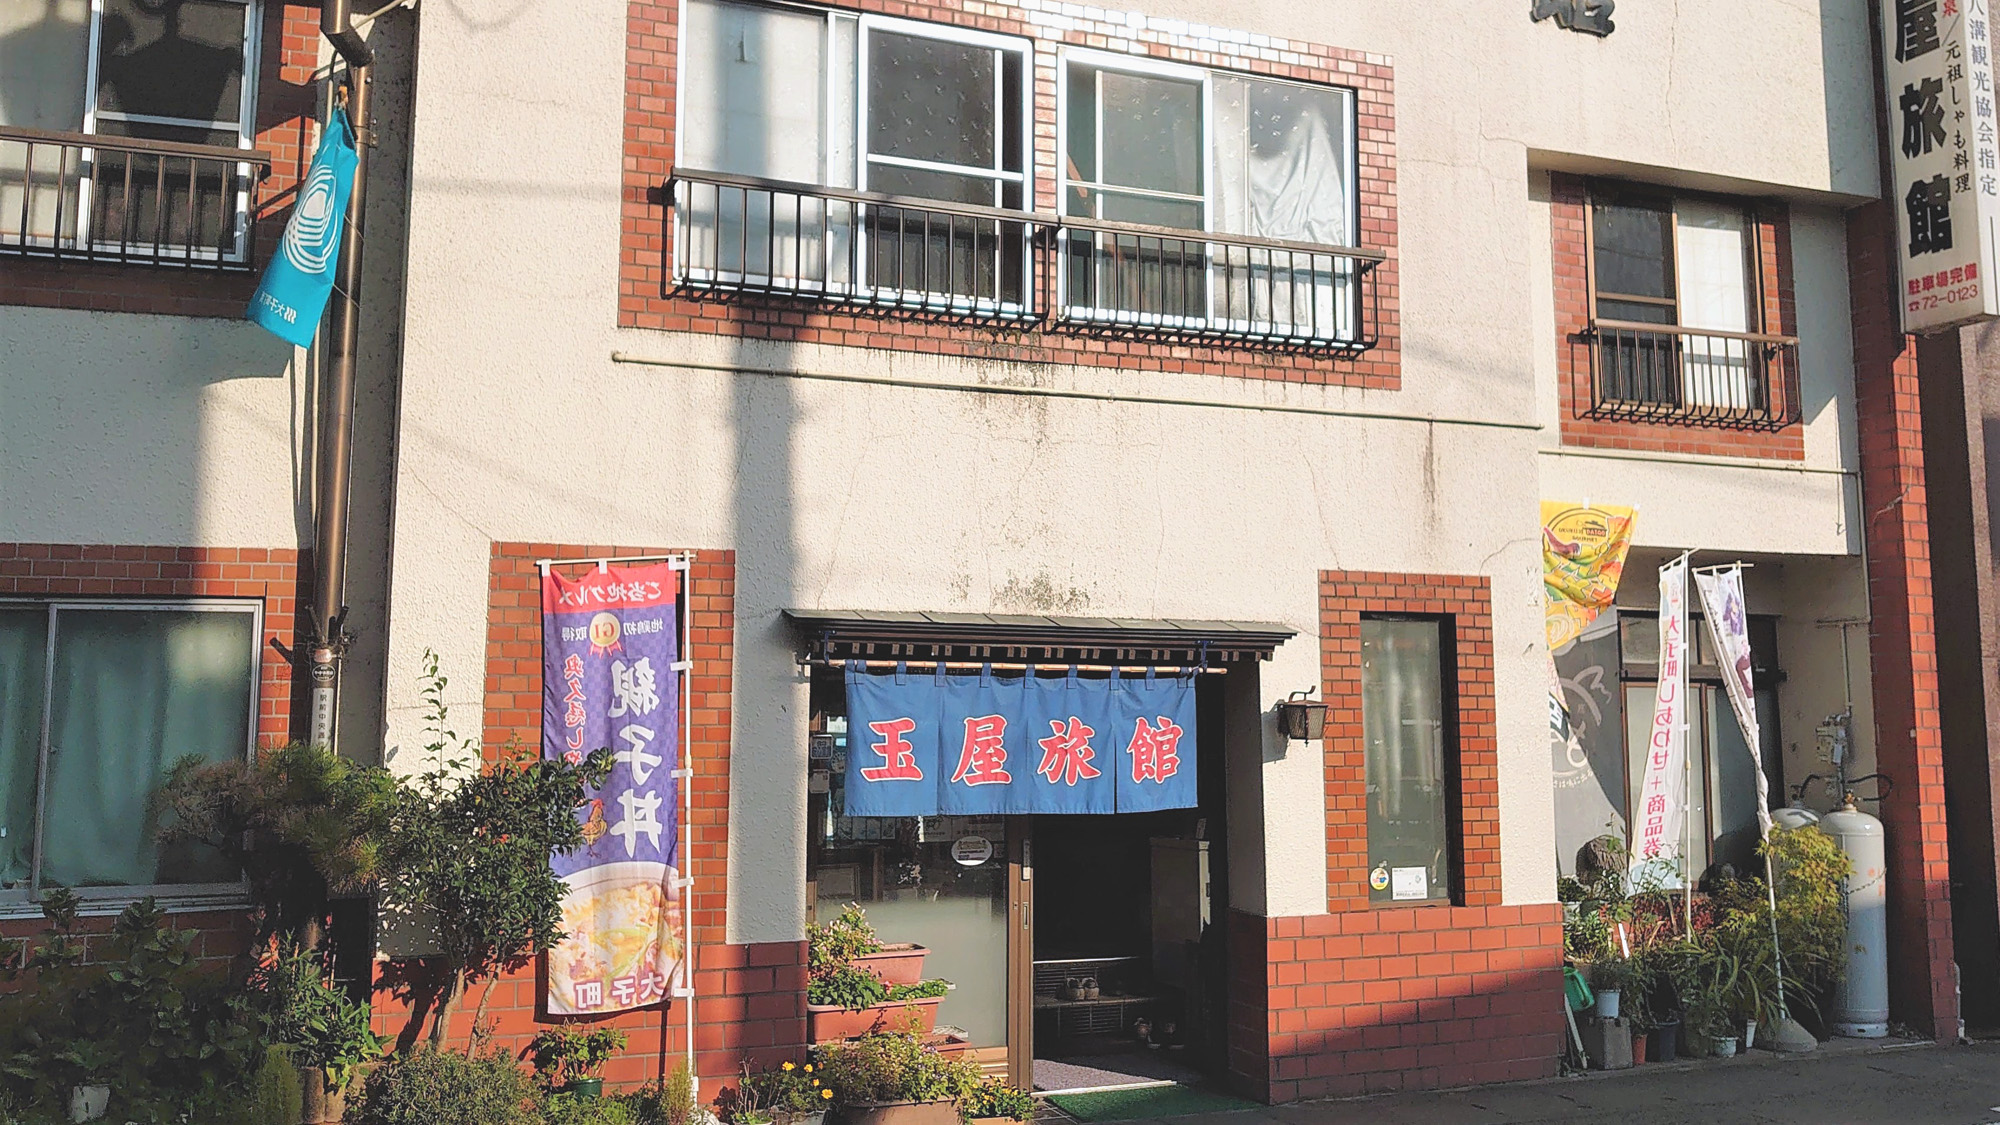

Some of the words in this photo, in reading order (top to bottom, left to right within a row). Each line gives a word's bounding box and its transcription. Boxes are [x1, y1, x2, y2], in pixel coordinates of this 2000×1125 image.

[1908, 262, 1977, 296] 駐車場完備
[1922, 284, 1978, 310] 72-0123
[860, 714, 1184, 787] 玉屋旅館
